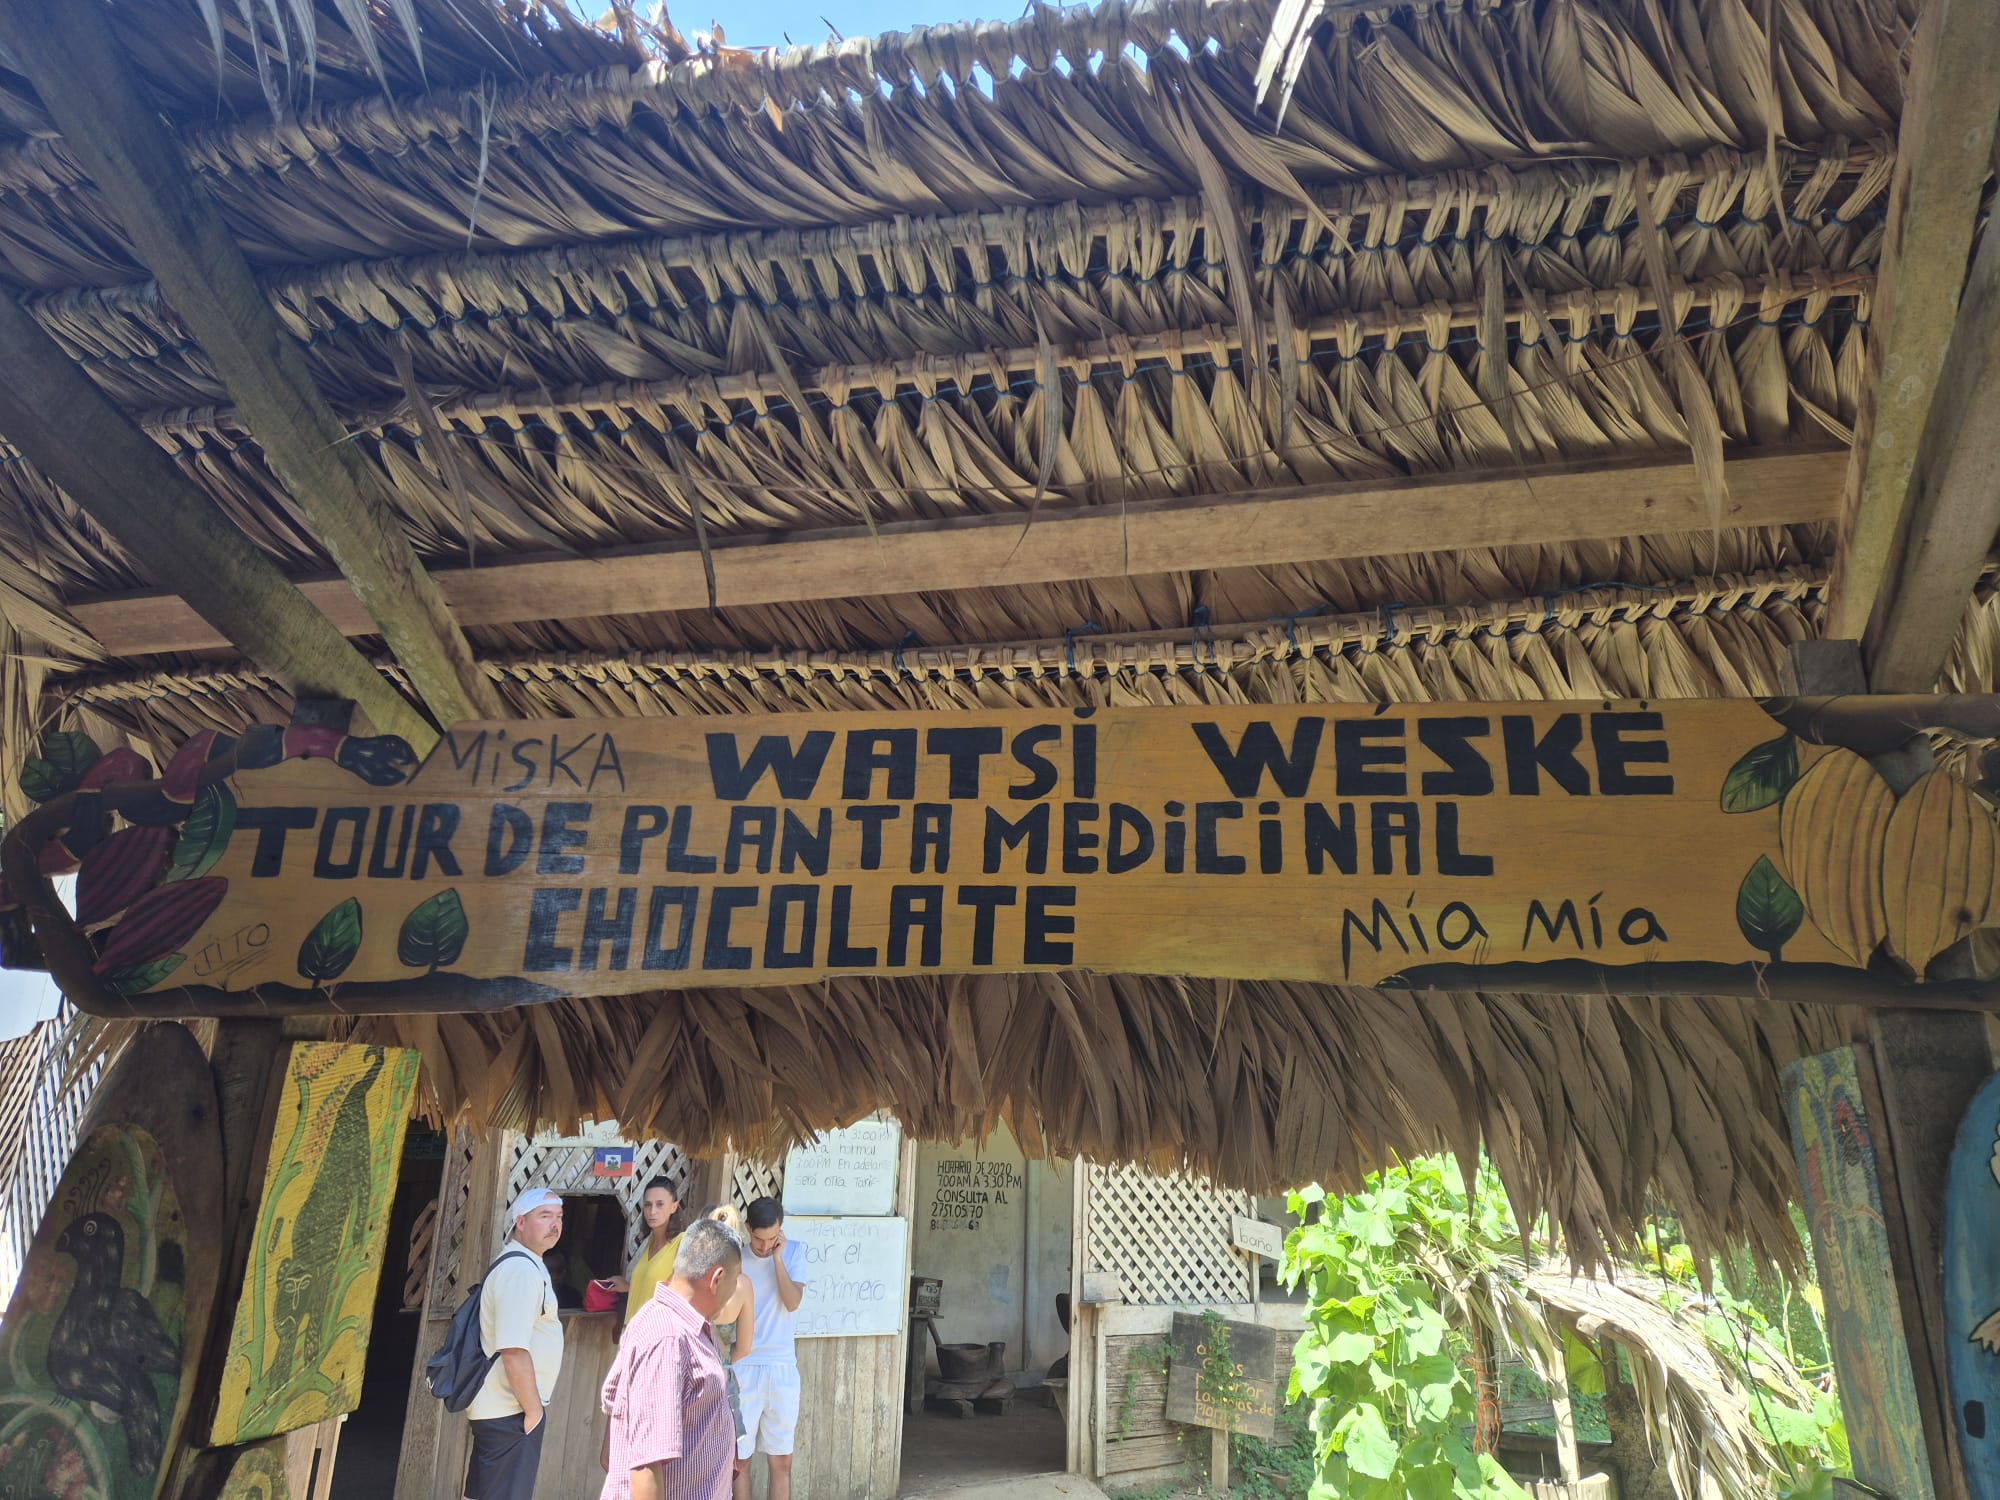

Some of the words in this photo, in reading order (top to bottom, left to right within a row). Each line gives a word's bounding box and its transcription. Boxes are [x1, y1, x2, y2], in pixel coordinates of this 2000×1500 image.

[232, 803, 463, 881] TOUR
[484, 802, 593, 877] DE
[618, 802, 953, 876] PLANTA
[523, 884, 1077, 972] CHOCOLATE
[937, 1160, 972, 1175] HORARIO
[935, 1188, 989, 1205] CONSULTA
[994, 1190, 1009, 1205] AL
[1239, 1226, 1273, 1253] baño
[844, 1241, 861, 1265] el
